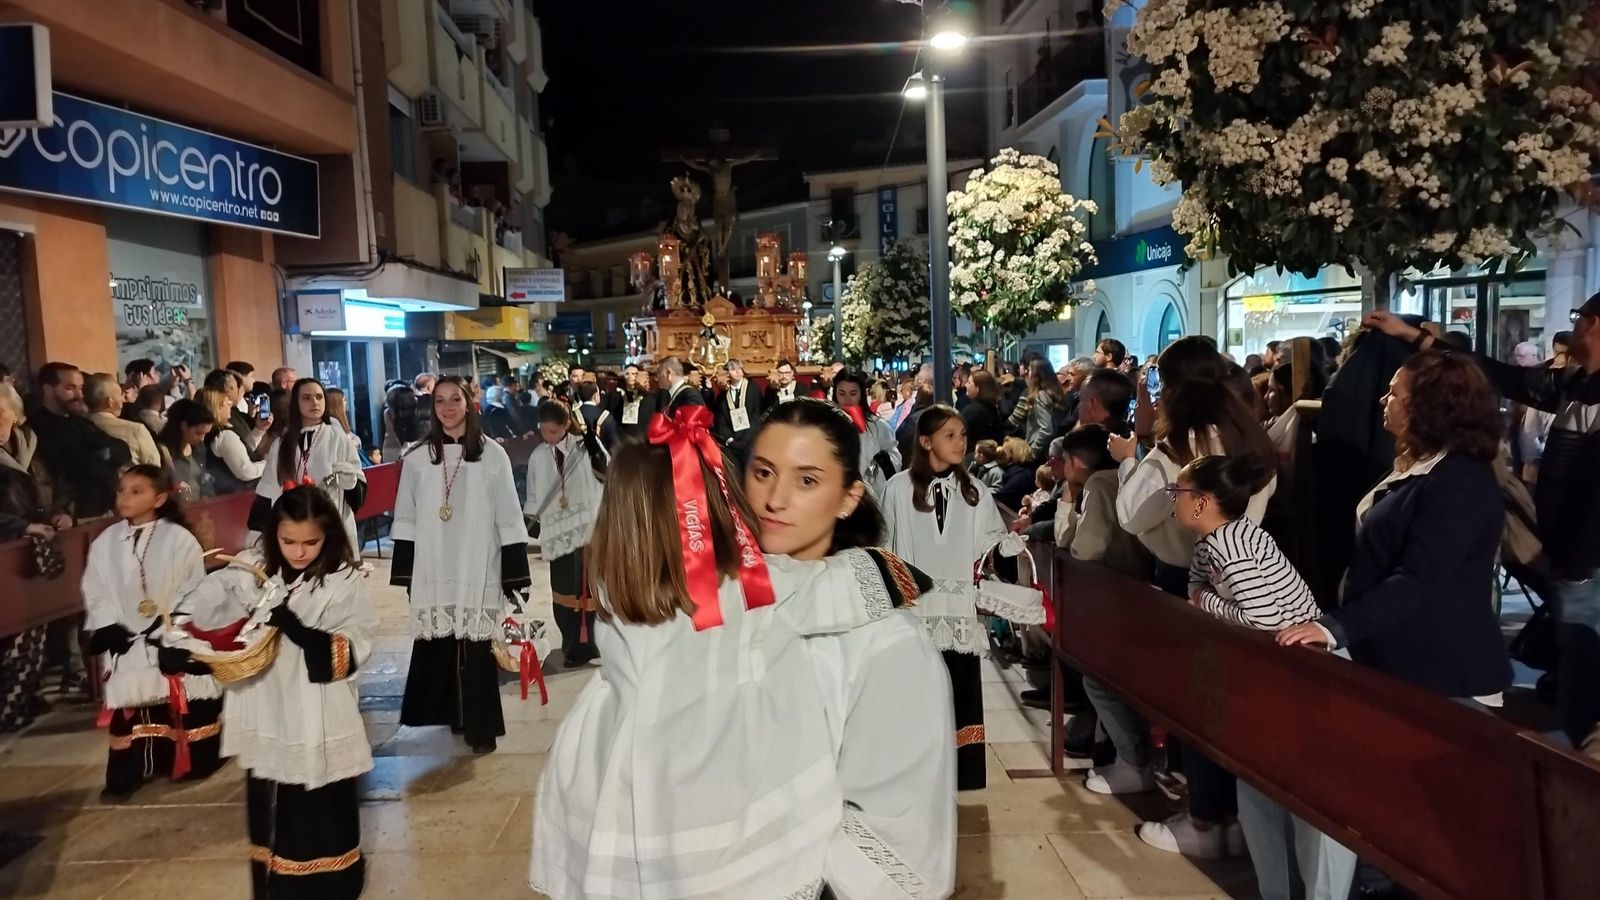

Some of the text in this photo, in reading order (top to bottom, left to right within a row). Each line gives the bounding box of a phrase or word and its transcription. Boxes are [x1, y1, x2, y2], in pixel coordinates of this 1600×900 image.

[32, 112, 282, 206] copicentro
[150, 188, 259, 219] www.copicentro.net
[1146, 241, 1172, 263] Unicaja
[109, 272, 198, 304] imprimimos
[123, 301, 189, 327] tus ideas
[683, 498, 706, 553] VIGÍAS
